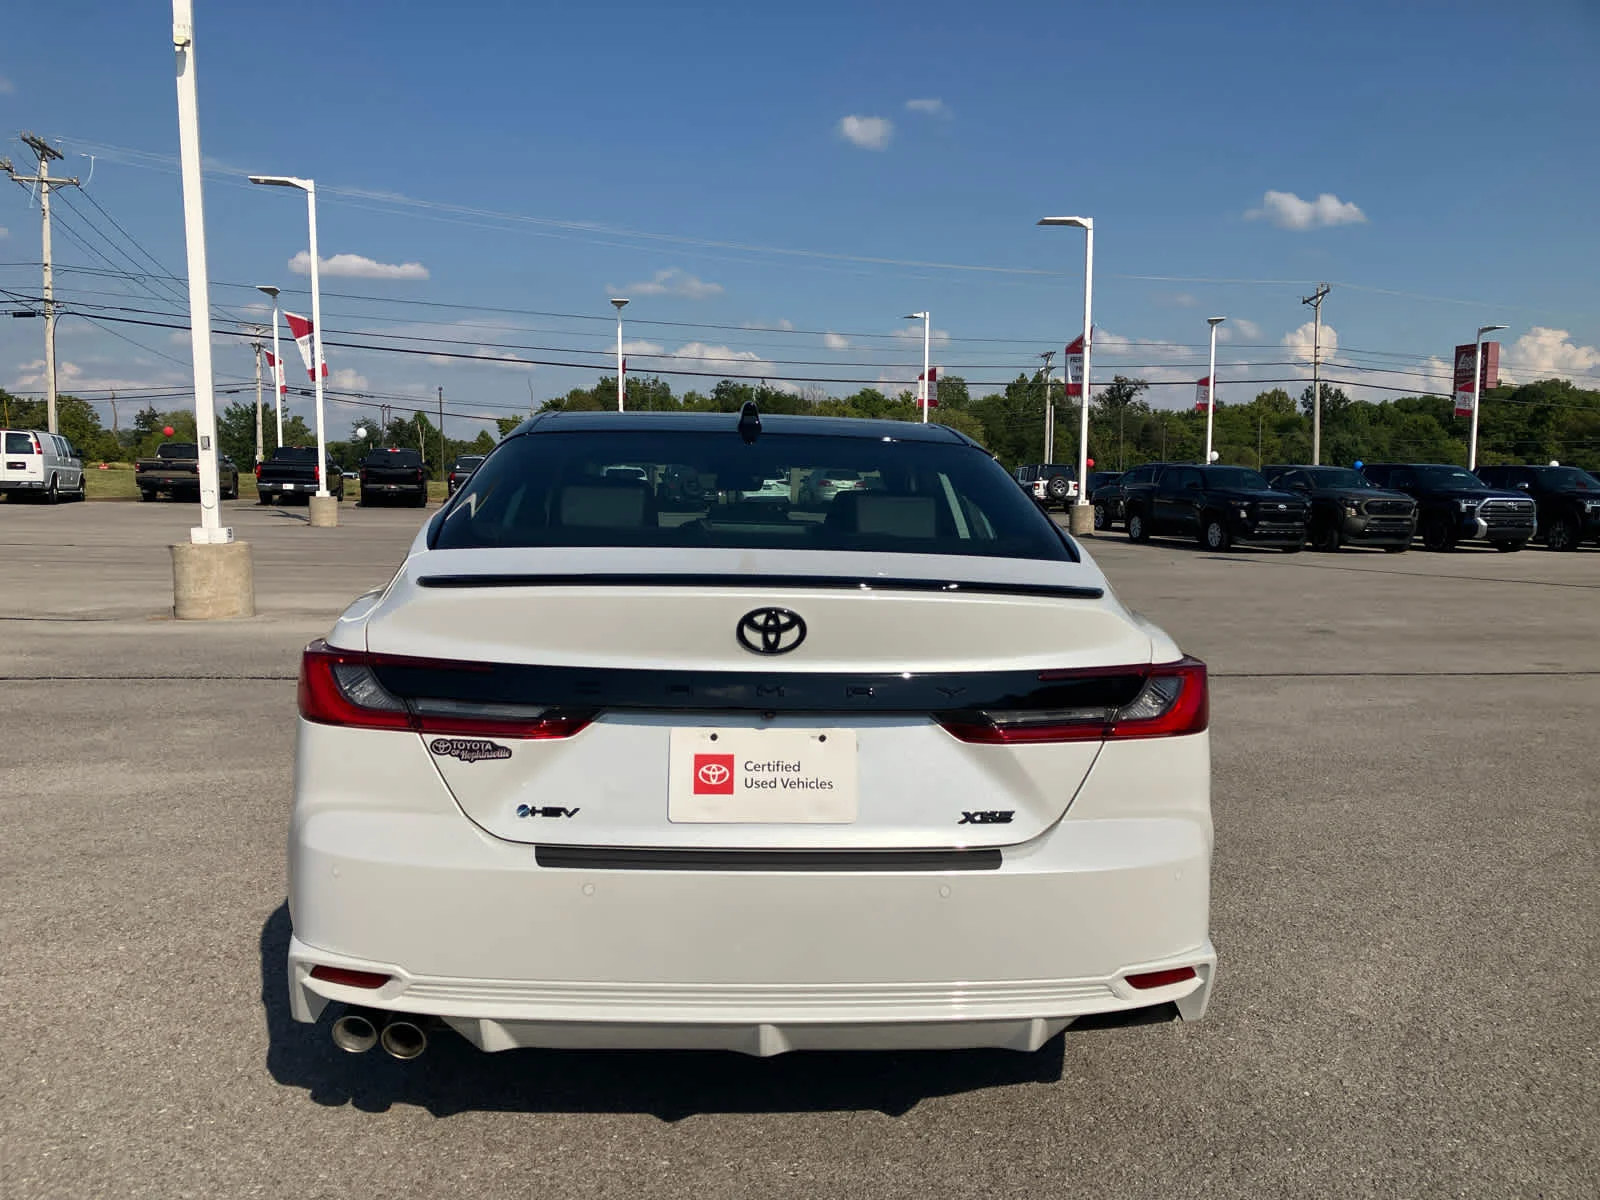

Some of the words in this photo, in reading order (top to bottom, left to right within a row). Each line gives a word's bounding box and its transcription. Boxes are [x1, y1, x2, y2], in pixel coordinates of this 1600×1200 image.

[452, 740, 492, 750] TOYOTA
[744, 760, 801, 773] Certified
[744, 777, 777, 789] Used
[780, 777, 834, 790] Vehicles
